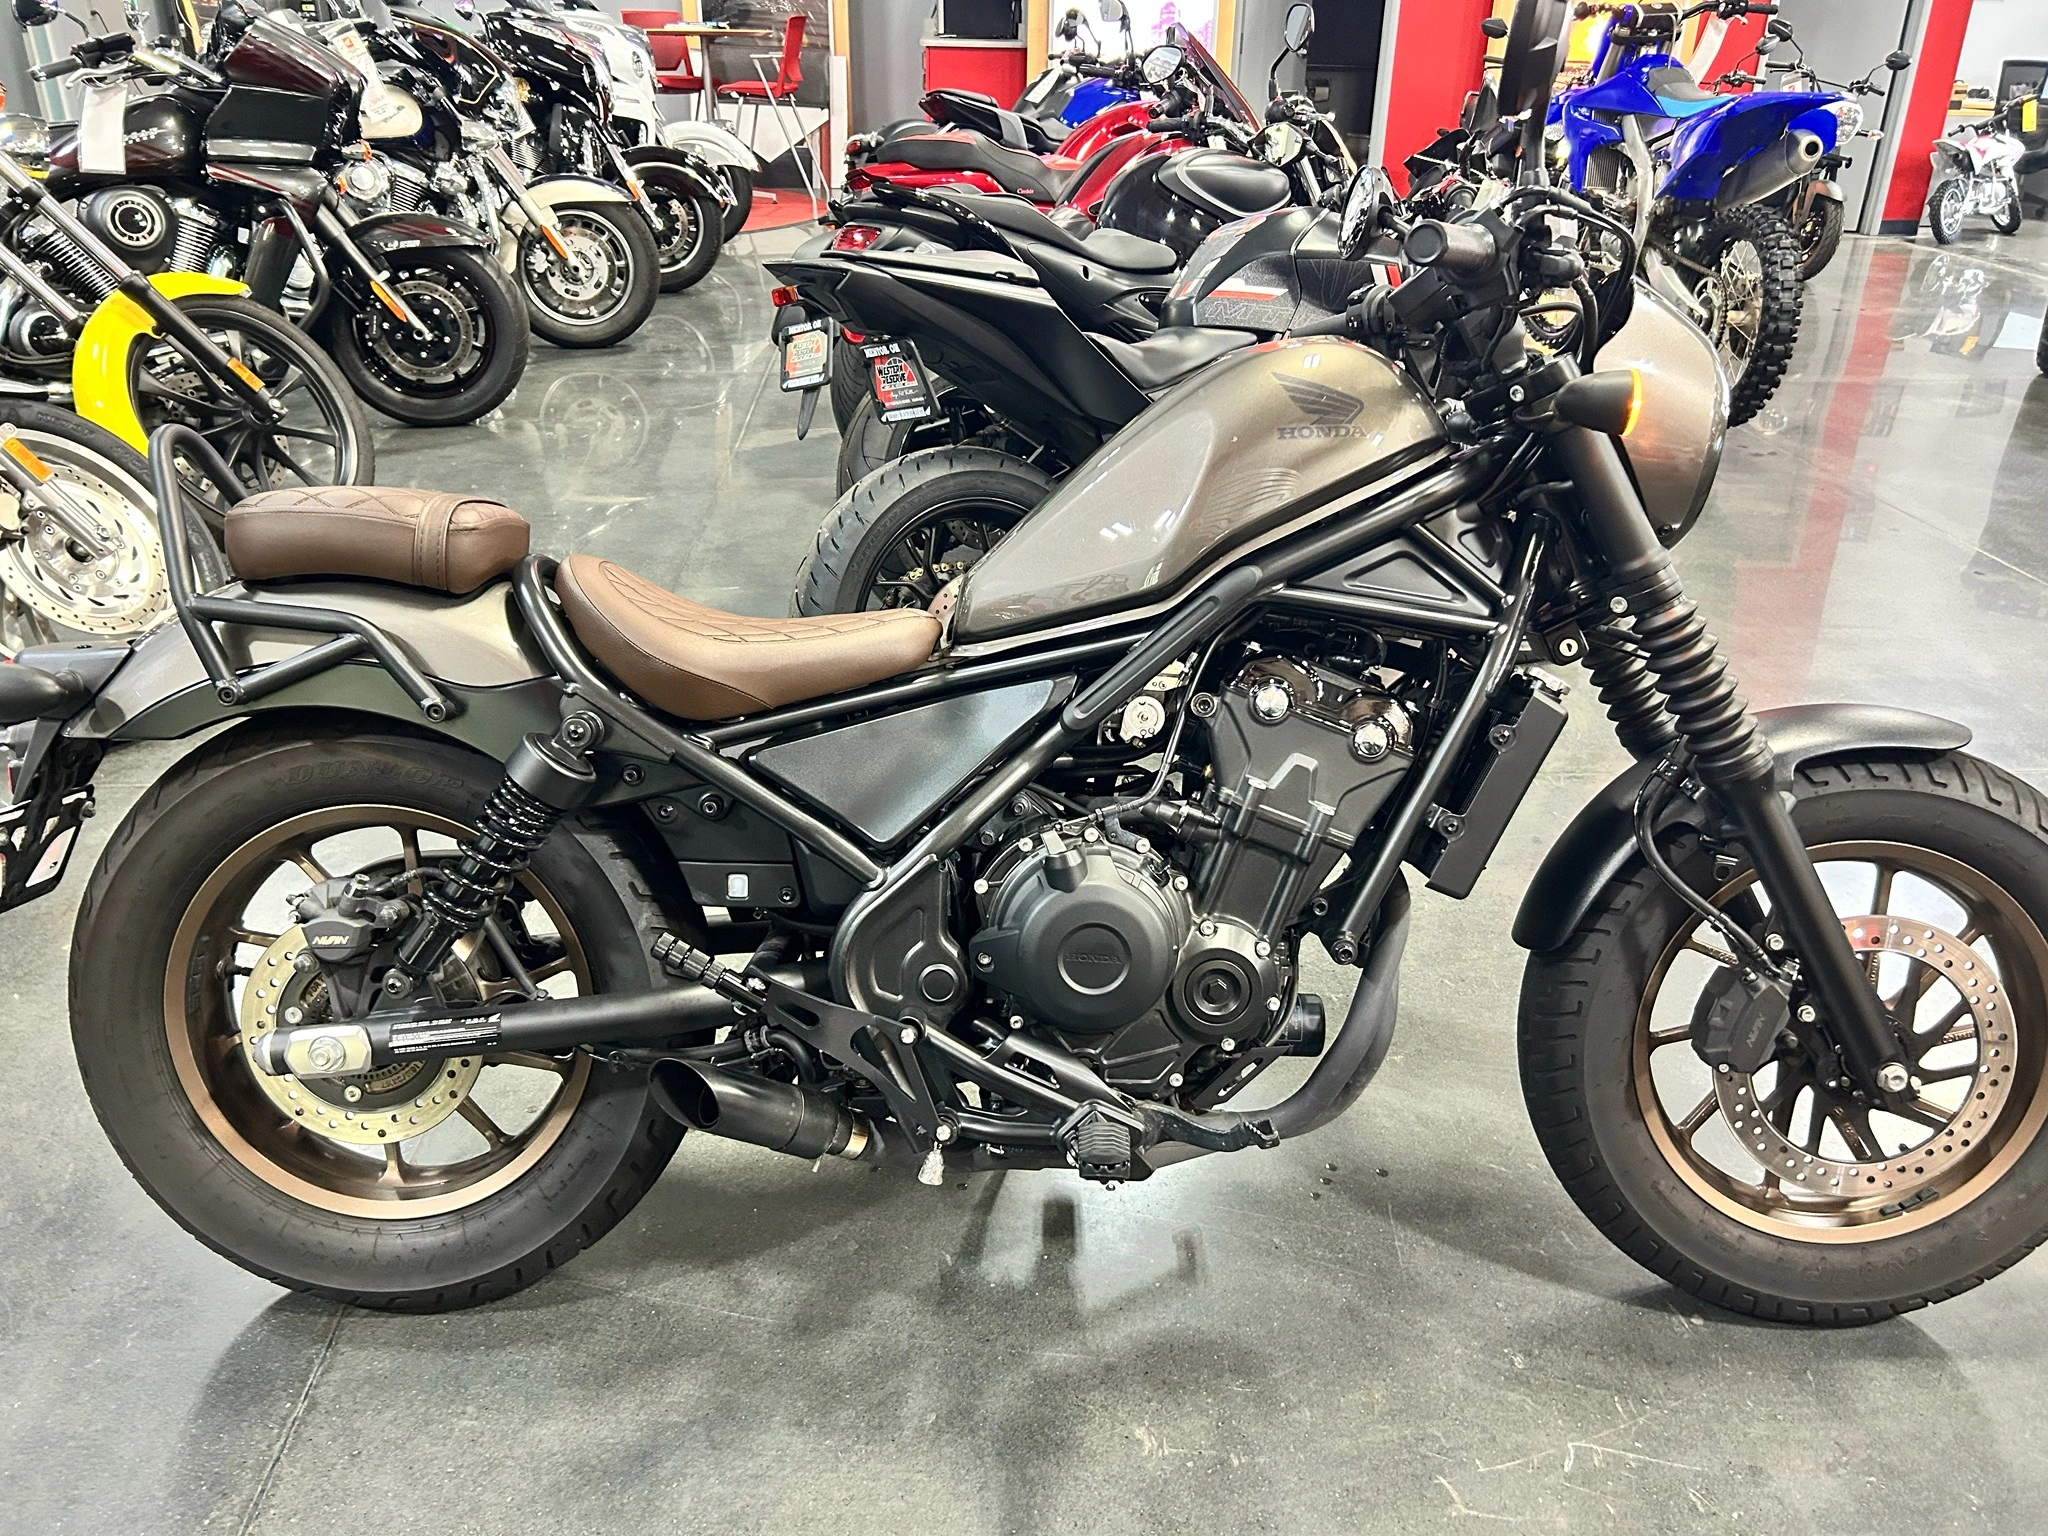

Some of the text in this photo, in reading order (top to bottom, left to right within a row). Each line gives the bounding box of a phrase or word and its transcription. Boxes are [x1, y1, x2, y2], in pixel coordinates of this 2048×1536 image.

[876, 364, 904, 377] WESTERN
[881, 373, 907, 385] RESERVE
[1277, 425, 1367, 440] HONDA
[286, 759, 464, 789] DUNLOP
[1064, 953, 1122, 965] HONDA
